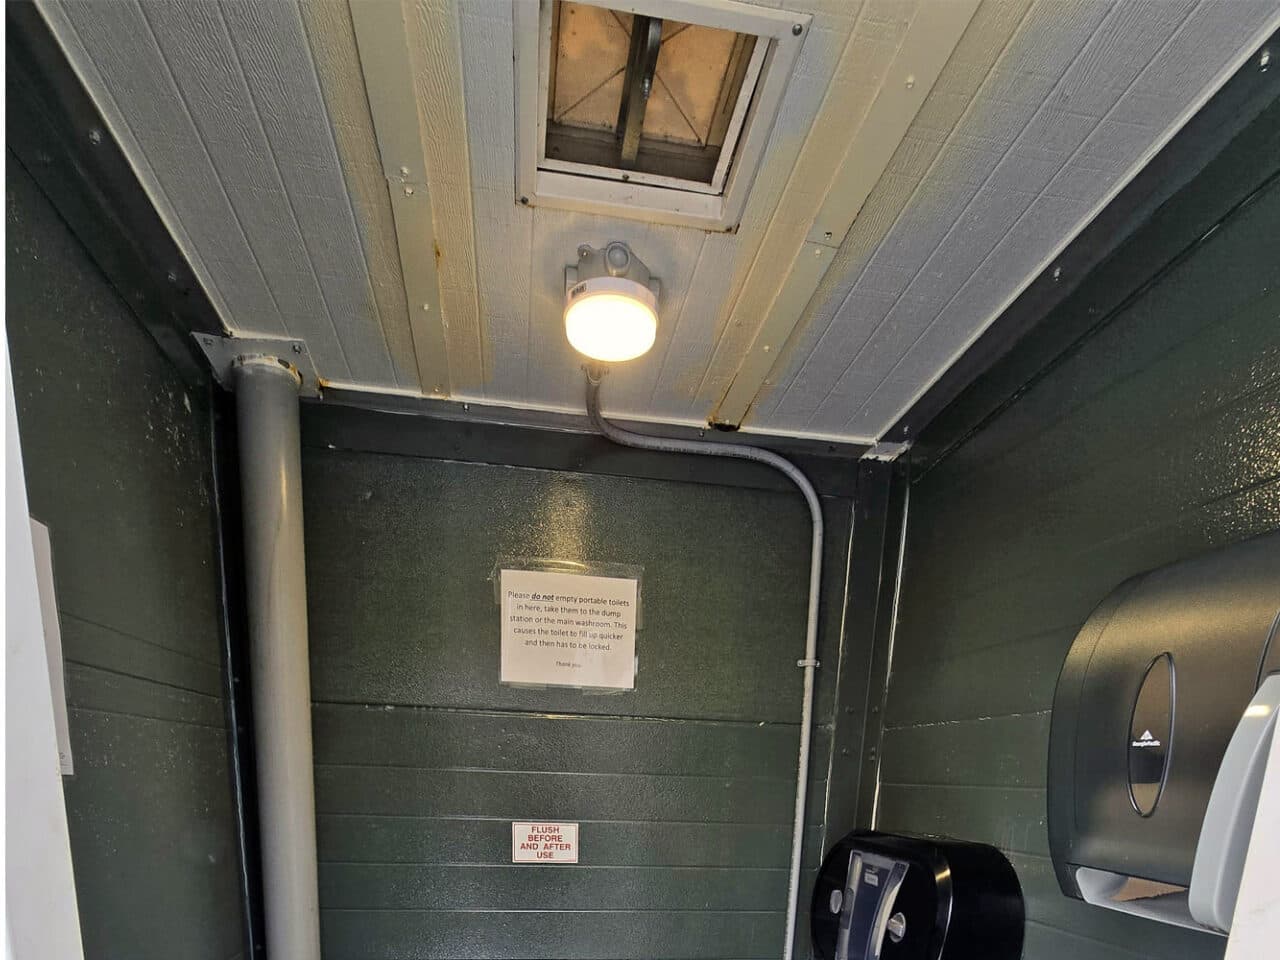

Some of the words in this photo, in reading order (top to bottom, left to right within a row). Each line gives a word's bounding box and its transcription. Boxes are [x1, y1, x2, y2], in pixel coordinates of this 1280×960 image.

[508, 590, 530, 599] Please
[555, 595, 577, 604] empty
[579, 596, 607, 605] portable
[608, 599, 630, 607] toilets
[544, 605, 559, 613] take
[560, 606, 579, 614] them
[580, 607, 587, 615] to
[601, 609, 621, 618] dump
[509, 615, 533, 623] station
[543, 616, 555, 624] the
[613, 621, 627, 630] This
[513, 627, 536, 635] causes
[537, 627, 549, 635] the
[550, 628, 569, 637] toilet
[570, 629, 577, 637] to
[579, 630, 587, 638] fill
[598, 632, 623, 641] quicker
[539, 639, 555, 647] then
[556, 640, 568, 648] has
[531, 826, 560, 834] FLUSH
[527, 834, 563, 842] BEFORE
[520, 842, 539, 850] AND
[543, 843, 571, 851] AFTER
[536, 851, 555, 859] USE
